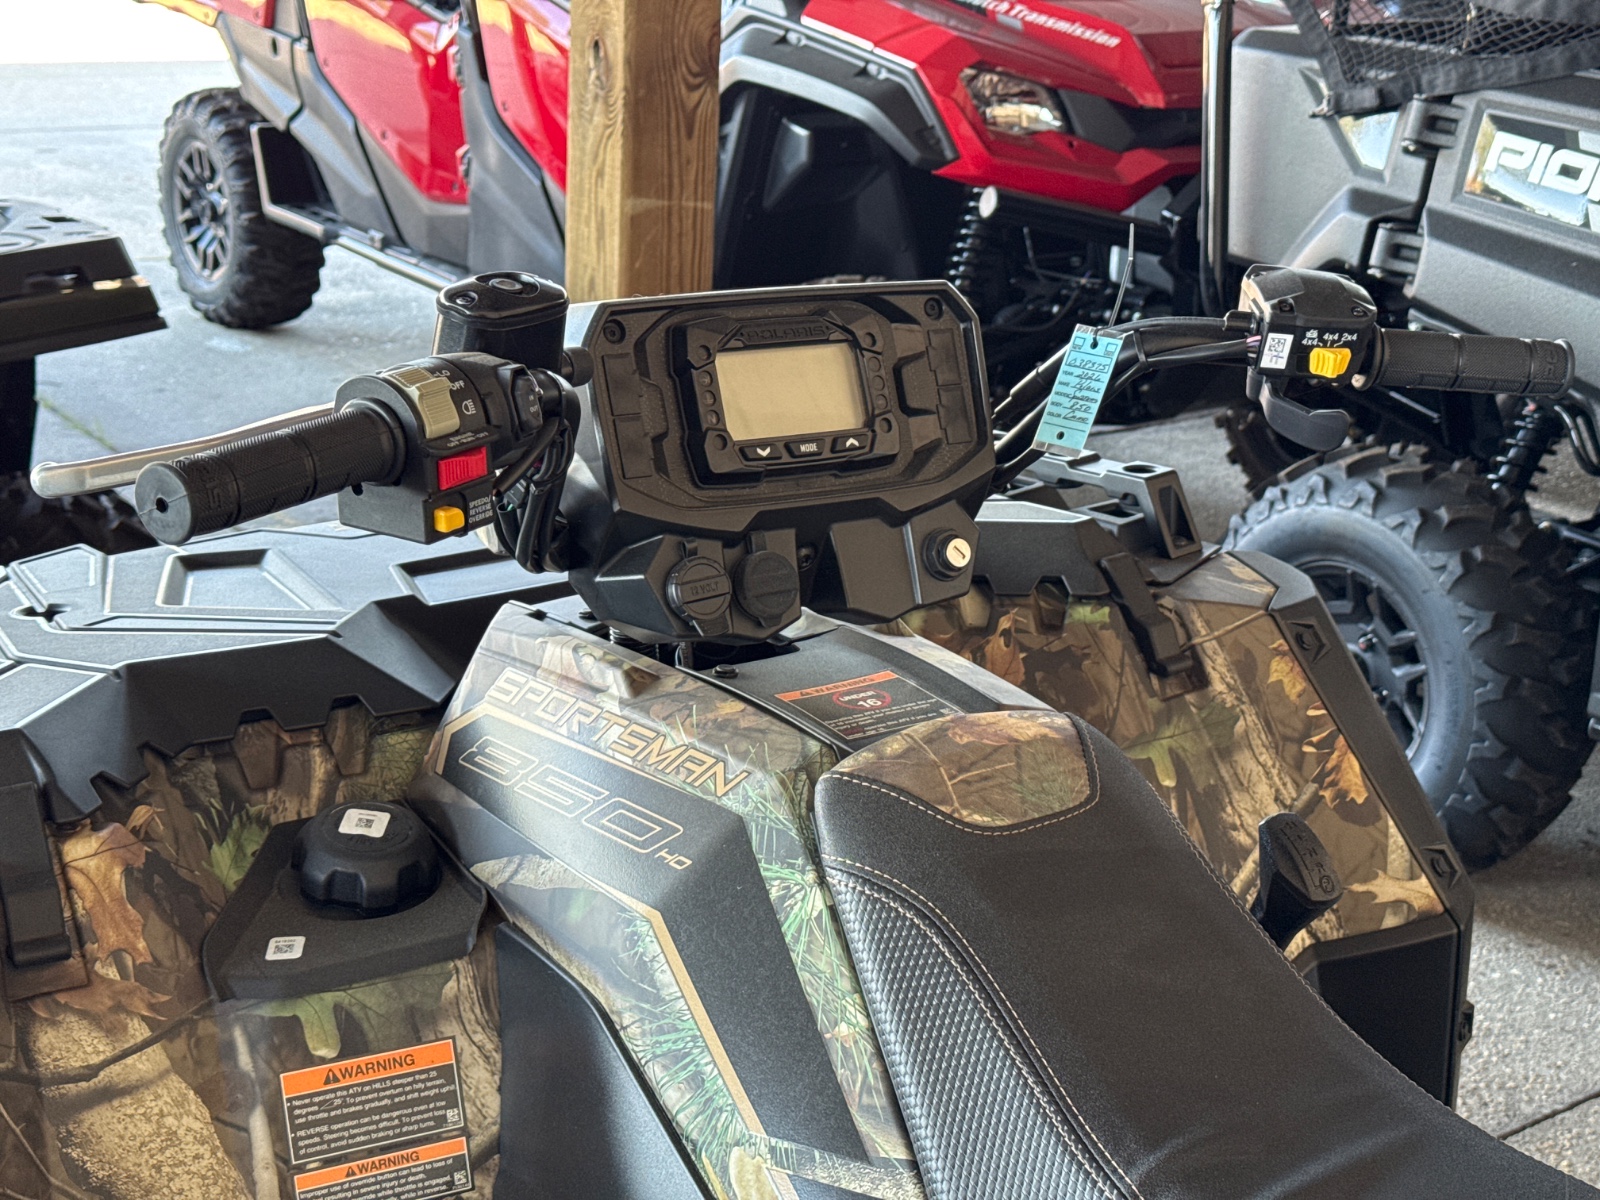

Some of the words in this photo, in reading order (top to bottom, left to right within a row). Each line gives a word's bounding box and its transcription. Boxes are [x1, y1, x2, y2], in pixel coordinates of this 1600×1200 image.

[1008, 3, 1122, 48] Transmission
[1483, 131, 1600, 201] PIO
[746, 326, 826, 340] POLARIS
[1302, 337, 1319, 346] 4x4
[1323, 332, 1339, 341] 4x4
[1342, 332, 1358, 341] 2x4
[450, 380, 465, 390] OFF
[800, 443, 818, 452] MODE
[469, 494, 491, 508] SPEEDO/
[470, 503, 491, 515] REVERSE
[469, 510, 493, 523] OVERRIDE
[690, 586, 700, 596] 12
[700, 581, 719, 594] VOLT
[839, 690, 877, 701] UNDER
[857, 698, 882, 708] 16
[485, 667, 751, 797] SPORTSMAN
[459, 736, 683, 853] 850
[655, 848, 693, 870] HO
[339, 1054, 415, 1080] WARNING
[292, 1098, 311, 1106] Never
[312, 1092, 335, 1102] operate
[349, 1086, 362, 1095] ATV
[372, 1080, 391, 1089] HILLS
[392, 1076, 414, 1086] steeper
[293, 1105, 319, 1115] degrees
[355, 1093, 378, 1103] prevent
[379, 1087, 403, 1097] overturn
[413, 1082, 425, 1090] hilly
[308, 1111, 329, 1120] throttle
[330, 1108, 342, 1116] and
[342, 1104, 363, 1113] brakes
[407, 1092, 419, 1100] shift
[420, 1087, 439, 1097] weight
[297, 1125, 329, 1137] REVERSE
[330, 1119, 359, 1130] operation
[360, 1116, 371, 1124] can
[381, 1108, 412, 1119] dangerous
[298, 1136, 321, 1147] speeds.
[323, 1131, 349, 1141] Steering
[349, 1125, 377, 1135] becomes
[411, 1112, 433, 1122] prevent
[330, 1139, 347, 1148] avoid
[348, 1134, 371, 1144] sudden
[371, 1128, 394, 1139] braking
[402, 1123, 418, 1132] sharp
[419, 1120, 436, 1128] turns.
[357, 1151, 420, 1174] WARNING
[300, 1187, 329, 1199] Improper
[350, 1176, 376, 1187] override
[376, 1171, 398, 1180] button
[433, 1160, 446, 1168] loss
[324, 1190, 352, 1200] resulting
[360, 1184, 380, 1193] severe
[382, 1180, 399, 1189] injury
[407, 1173, 427, 1182] death.
[377, 1189, 394, 1197] while
[394, 1183, 417, 1193] throttle
[424, 1174, 452, 1186] engaged.
[400, 1191, 416, 1200] while
[424, 1184, 449, 1194] reverse.
